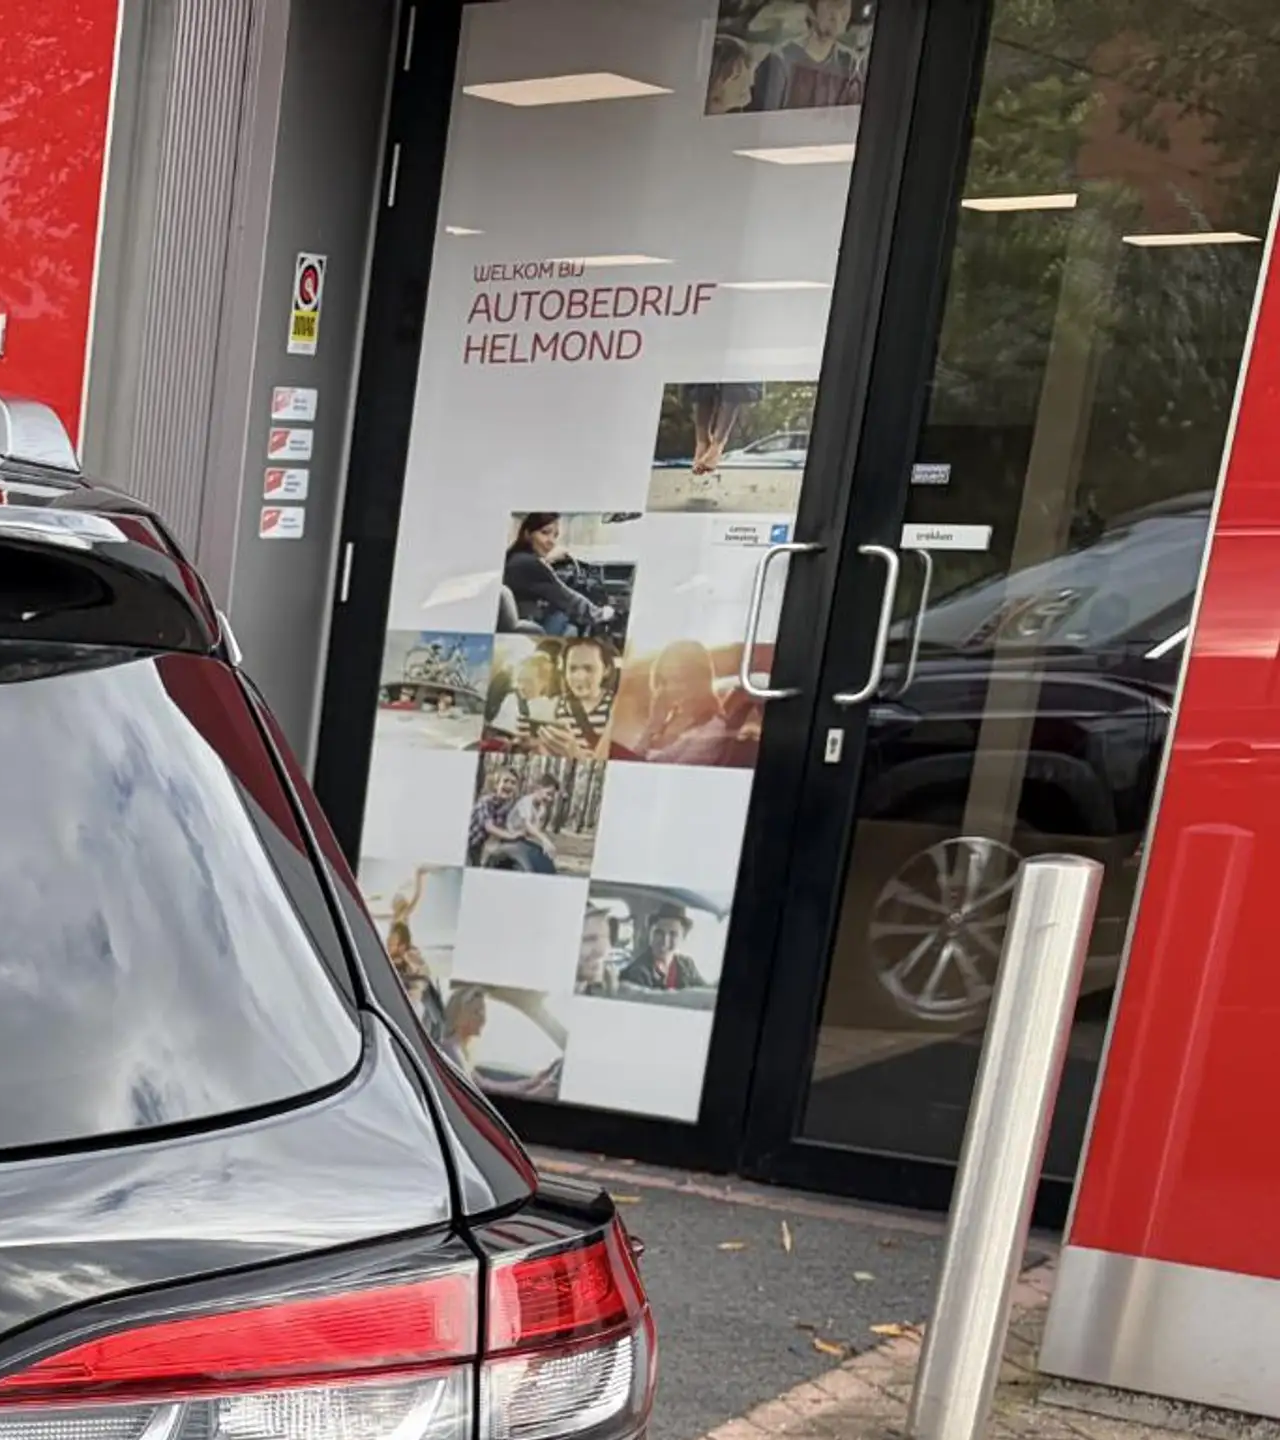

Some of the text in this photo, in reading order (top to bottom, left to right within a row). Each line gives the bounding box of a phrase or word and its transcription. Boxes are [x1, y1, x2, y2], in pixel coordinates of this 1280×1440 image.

[474, 258, 585, 283] WELKOM BIJ
[467, 283, 718, 324] AUTOBEDRIJF
[463, 329, 643, 364] HELMOND
